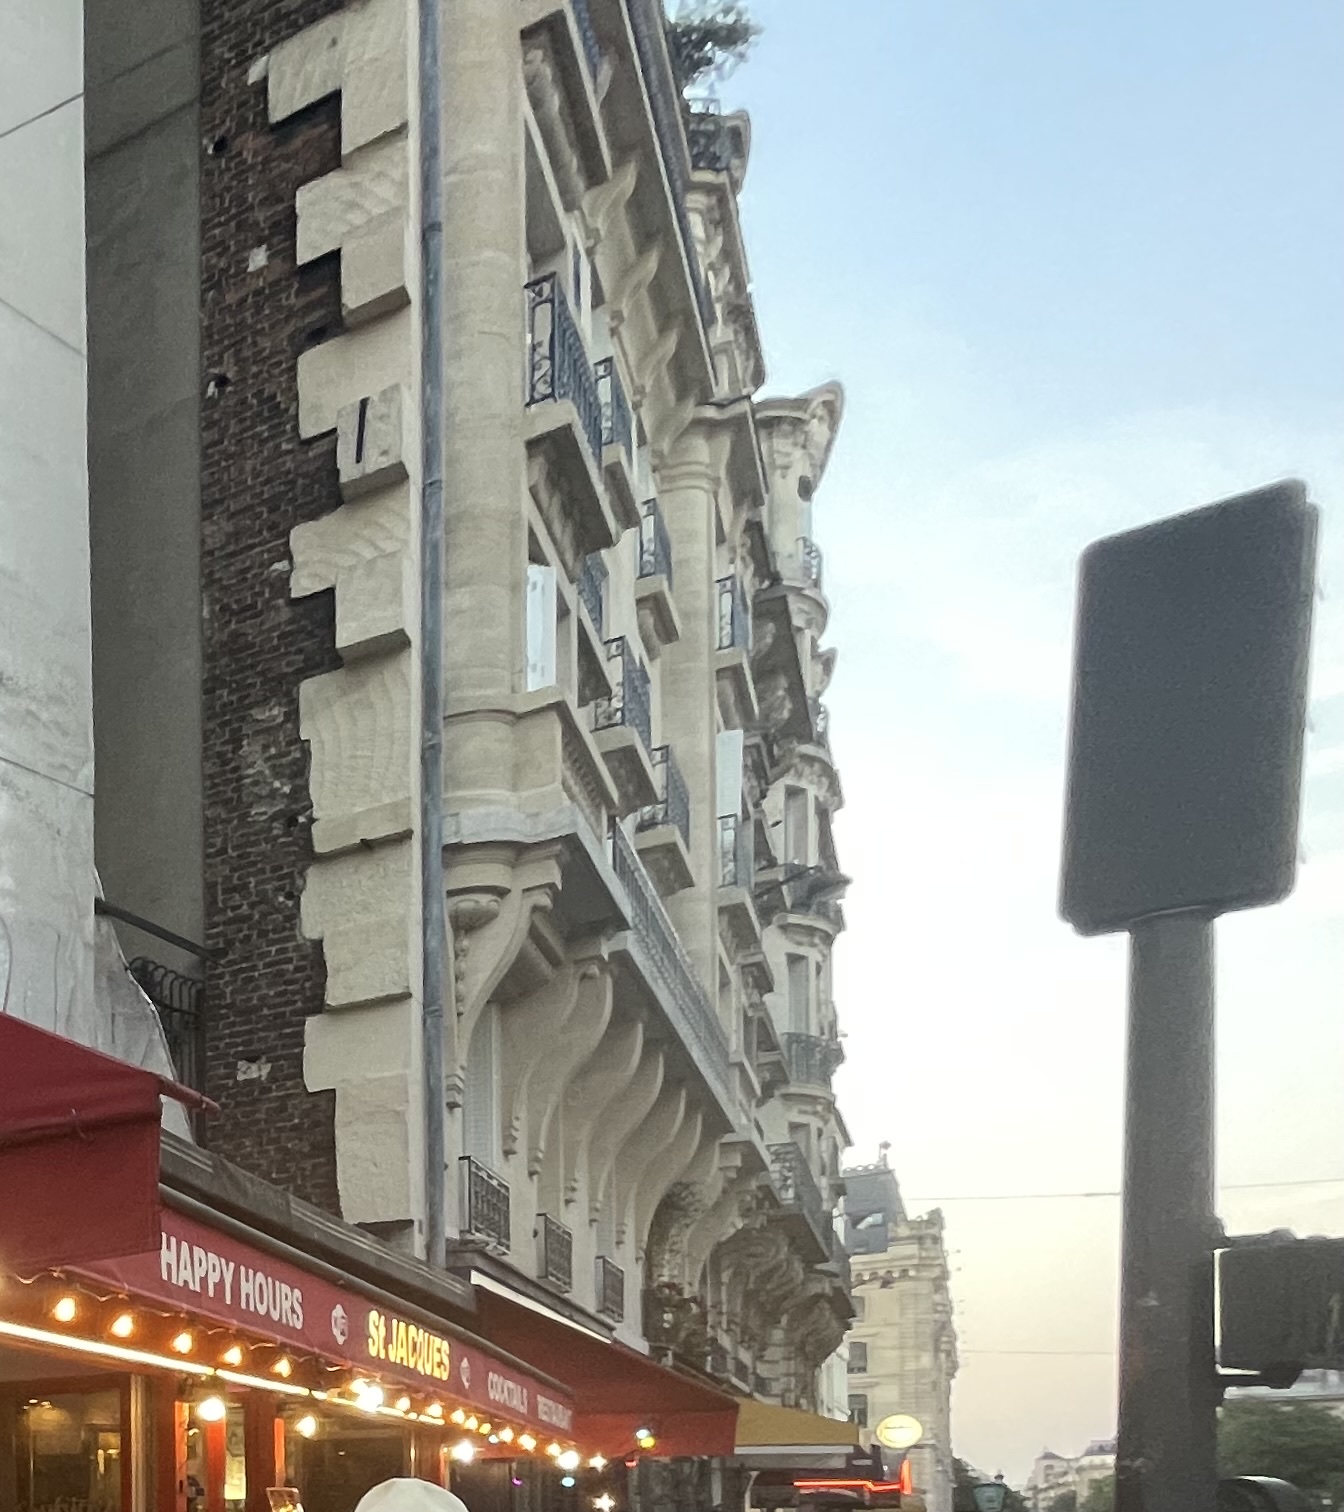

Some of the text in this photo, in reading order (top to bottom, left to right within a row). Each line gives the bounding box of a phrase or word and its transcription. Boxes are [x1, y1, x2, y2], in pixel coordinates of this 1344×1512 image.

[161, 1231, 303, 1330] HAPPY HOURS
[368, 1309, 450, 1382] St JACQUES
